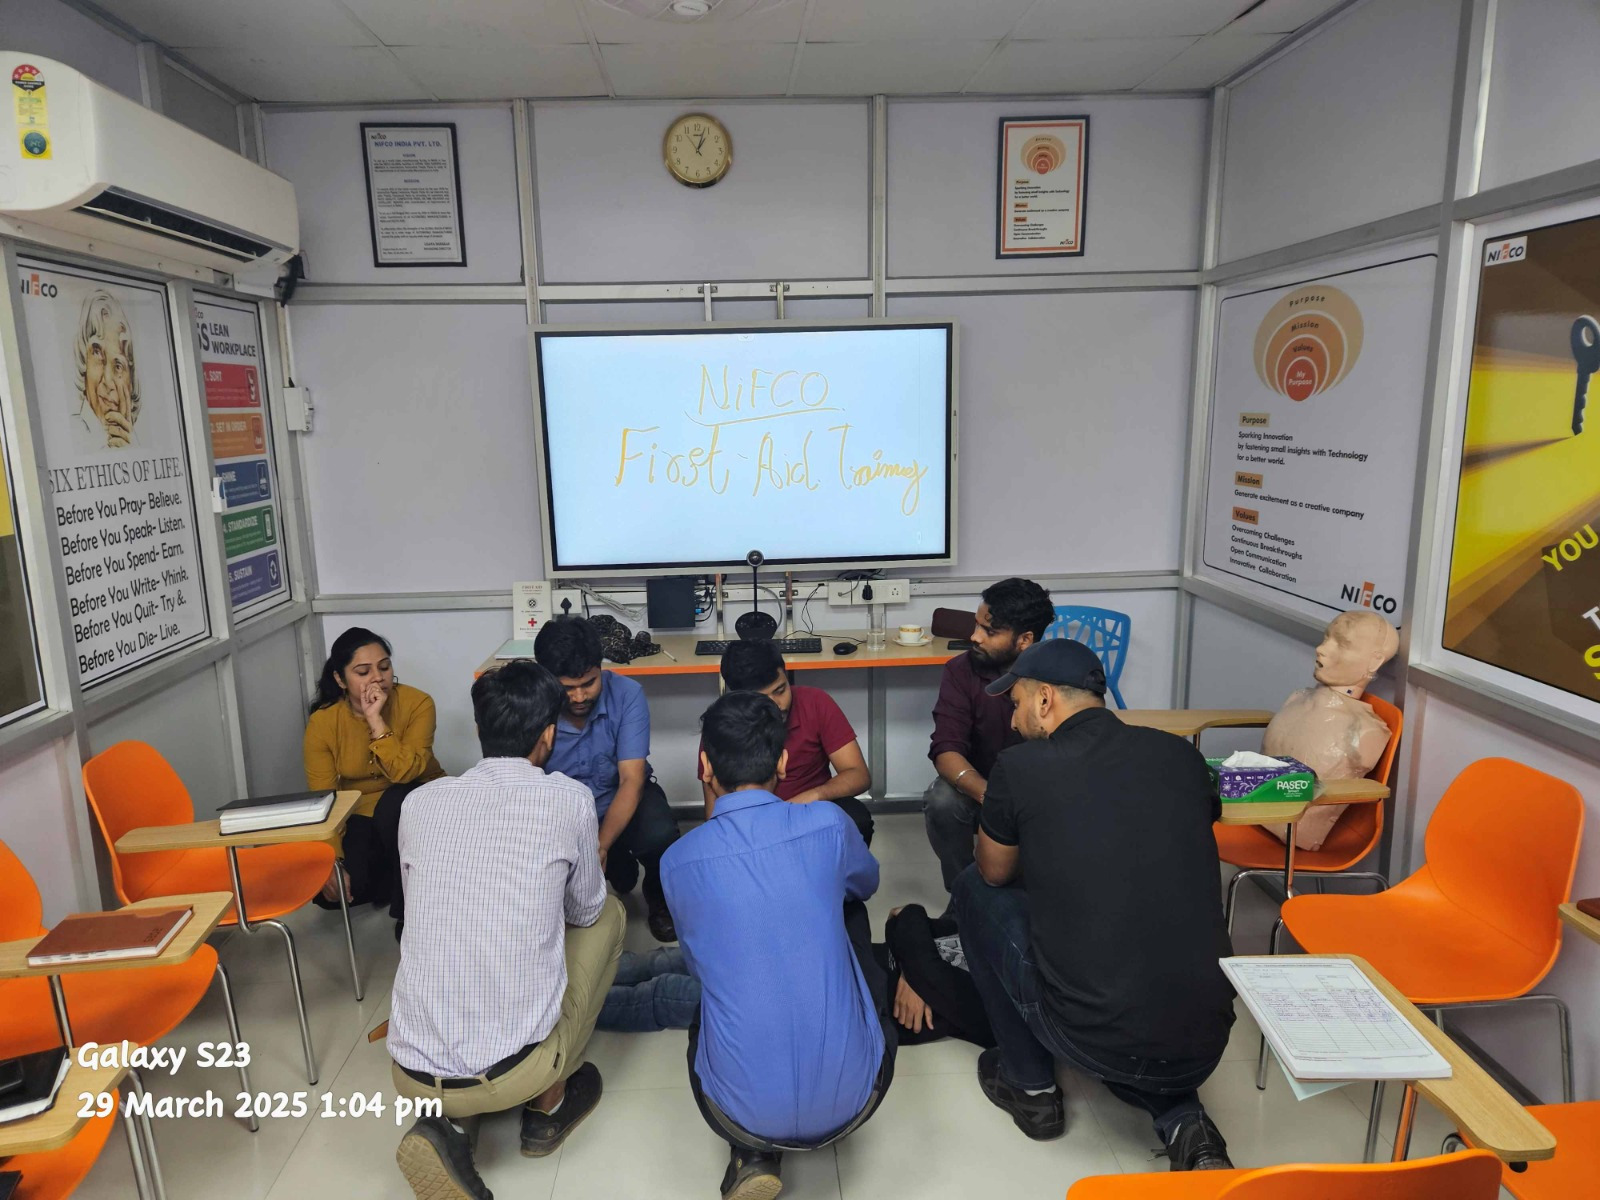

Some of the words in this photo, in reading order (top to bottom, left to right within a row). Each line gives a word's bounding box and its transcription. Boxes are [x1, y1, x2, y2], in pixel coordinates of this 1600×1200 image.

[1487, 243, 1524, 262] NIFCO
[209, 322, 230, 337] LEAN
[1291, 320, 1319, 332] Mission
[212, 341, 256, 357] WORKPLACE
[1242, 416, 1267, 425] Purpose
[1238, 431, 1262, 440] Sparking
[1263, 432, 1293, 441] Innovation
[1238, 442, 1244, 450] by
[1245, 444, 1269, 453] fastening
[1271, 445, 1286, 453] small
[1287, 447, 1310, 456] insights
[1312, 448, 1326, 457] with
[1328, 450, 1368, 462] Technology
[1250, 455, 1266, 463] better
[1268, 457, 1285, 465] world.
[74, 462, 130, 490] ETHICS
[133, 460, 150, 482] OF
[152, 457, 183, 480] LIFE.
[1237, 475, 1259, 485] Mission
[56, 504, 94, 526] Before
[95, 500, 117, 519] You
[119, 497, 146, 515] Pray-
[148, 491, 182, 509] Believe.
[1234, 490, 1258, 500] Generate
[1259, 494, 1289, 506] excitement
[1305, 502, 1330, 512] creative
[1332, 507, 1364, 520] company
[1236, 510, 1256, 521] Values
[61, 534, 98, 556] Before
[100, 530, 121, 546] You
[123, 520, 156, 544] Speak-
[158, 518, 185, 533] Listen.
[1232, 524, 1262, 538] Overcoming
[1264, 528, 1295, 546] Challenges
[1230, 546, 1245, 555] Open
[1245, 549, 1287, 568] Communication
[1231, 535, 1259, 549] Continuous
[1260, 542, 1302, 560] Breakthroughs
[1541, 524, 1599, 572] YOU
[66, 563, 102, 585] Before
[104, 556, 125, 574] You
[127, 546, 160, 570] Spend-
[162, 543, 184, 559] Earn.
[1229, 557, 1256, 570] Innovative
[1258, 565, 1296, 583] Collaboration
[70, 594, 106, 617] Before
[108, 586, 129, 604] You
[130, 577, 160, 597] Write-
[1341, 581, 1397, 614] NIFCO
[74, 619, 110, 643] Before
[112, 611, 132, 629] You
[135, 601, 159, 623] Quit-
[160, 595, 174, 612] Try
[79, 650, 114, 674] Before
[116, 640, 136, 658] You
[138, 631, 158, 650] Die-
[159, 623, 180, 640] Live.
[1277, 780, 1308, 790] PASEO
